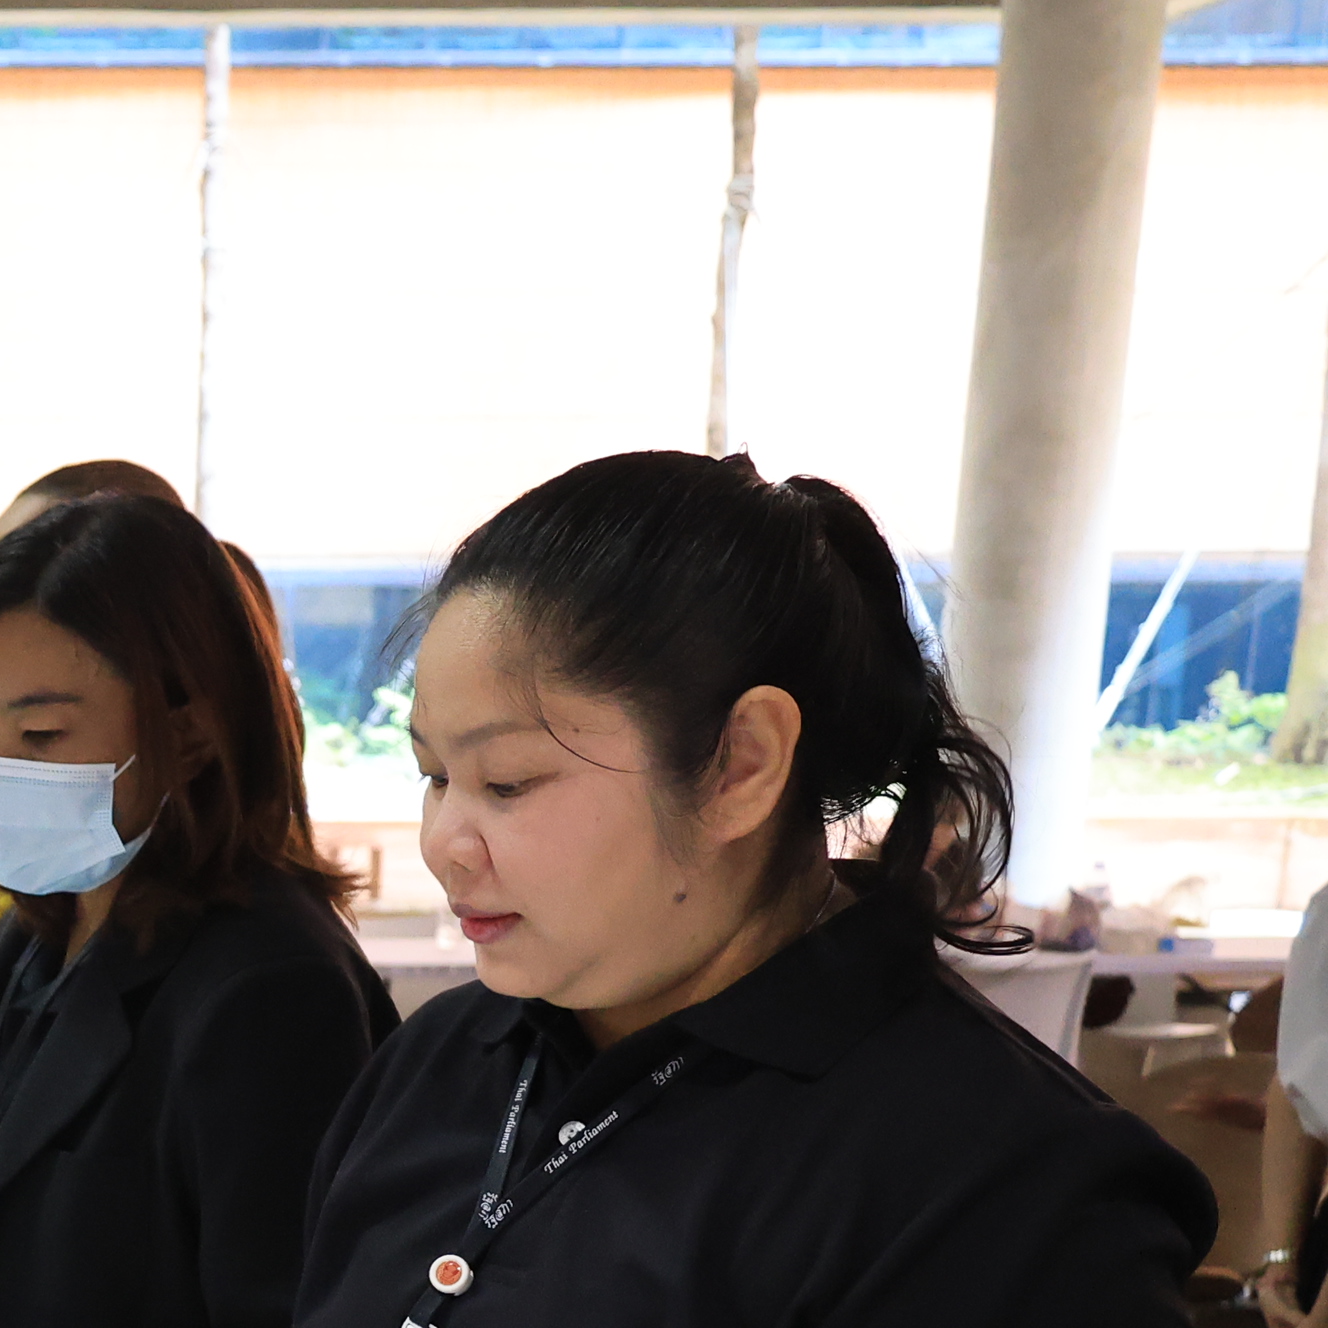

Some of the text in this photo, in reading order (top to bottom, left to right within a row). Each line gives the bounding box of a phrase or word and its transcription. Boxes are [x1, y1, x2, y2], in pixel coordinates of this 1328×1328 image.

[498, 1079, 528, 1154] Thai Parliament
[543, 1110, 620, 1175] Thai Parliament
